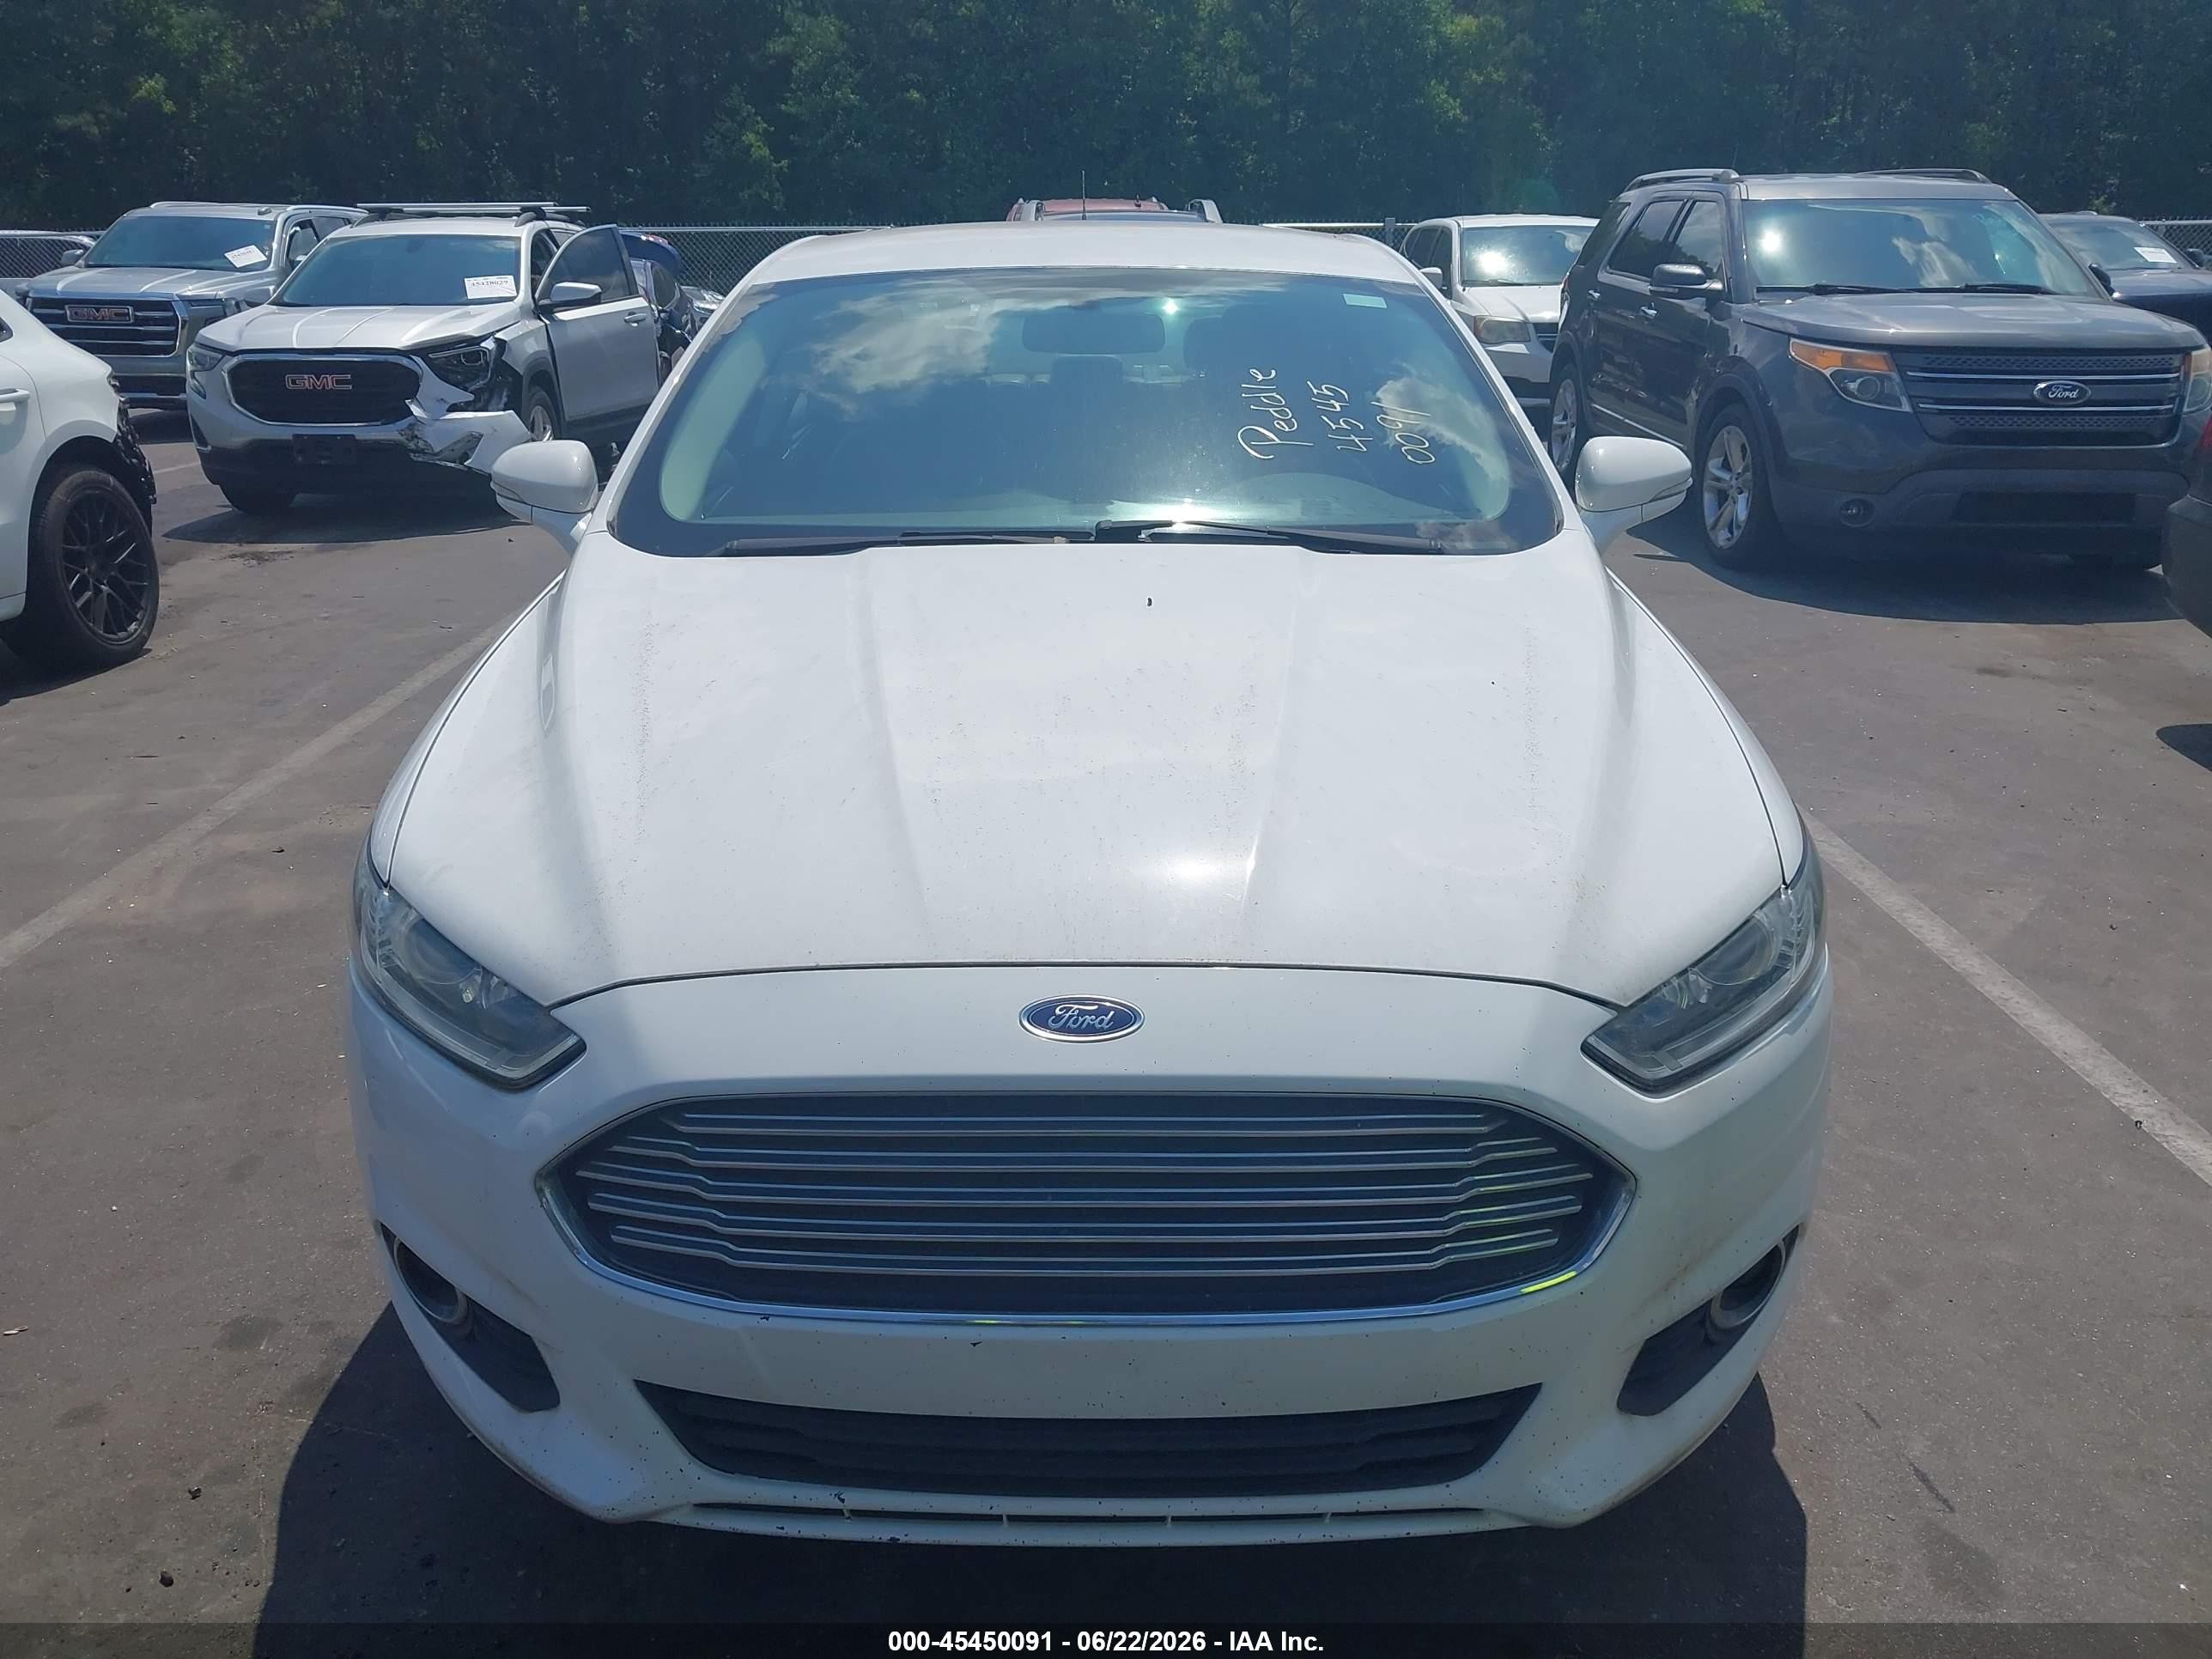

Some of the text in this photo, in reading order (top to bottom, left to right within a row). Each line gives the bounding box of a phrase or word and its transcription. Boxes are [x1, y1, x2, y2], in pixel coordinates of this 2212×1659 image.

[70, 308, 129, 320] GMC
[285, 374, 353, 390] GMC
[2048, 384, 2080, 398] Ford
[1237, 368, 1315, 460] Peddle
[1306, 380, 1374, 453] 4545
[1370, 401, 1437, 465] 0091
[1048, 1004, 1115, 1030] Ford
